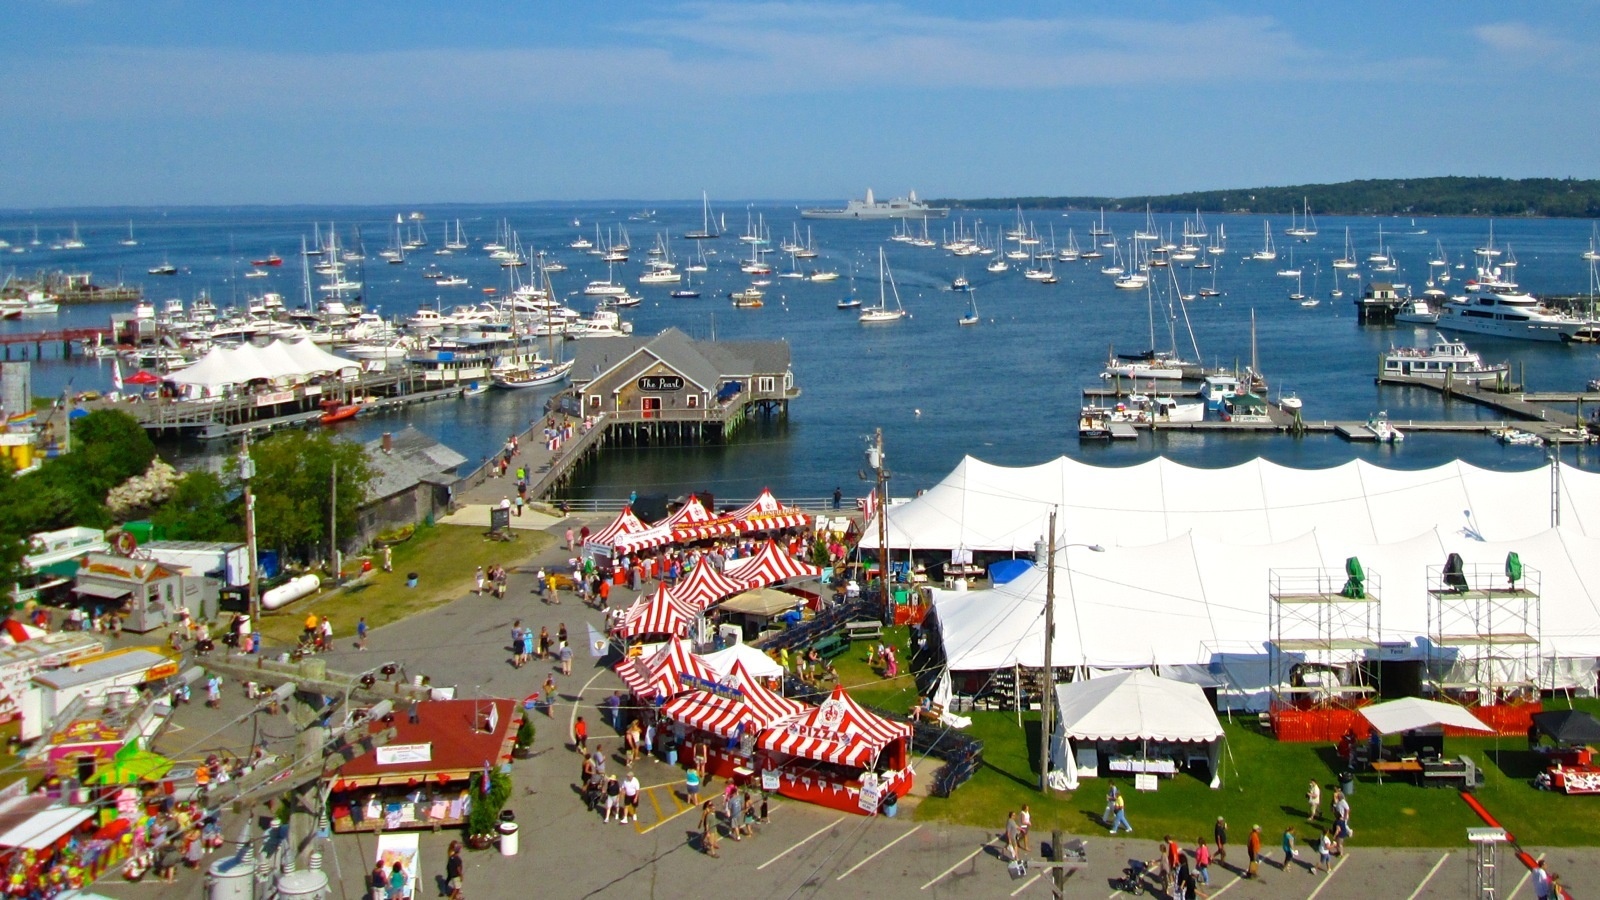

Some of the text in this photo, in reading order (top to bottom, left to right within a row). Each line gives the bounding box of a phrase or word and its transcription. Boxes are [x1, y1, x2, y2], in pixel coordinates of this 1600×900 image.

[641, 377, 680, 389] The Pearl
[799, 725, 840, 742] PIZZA
